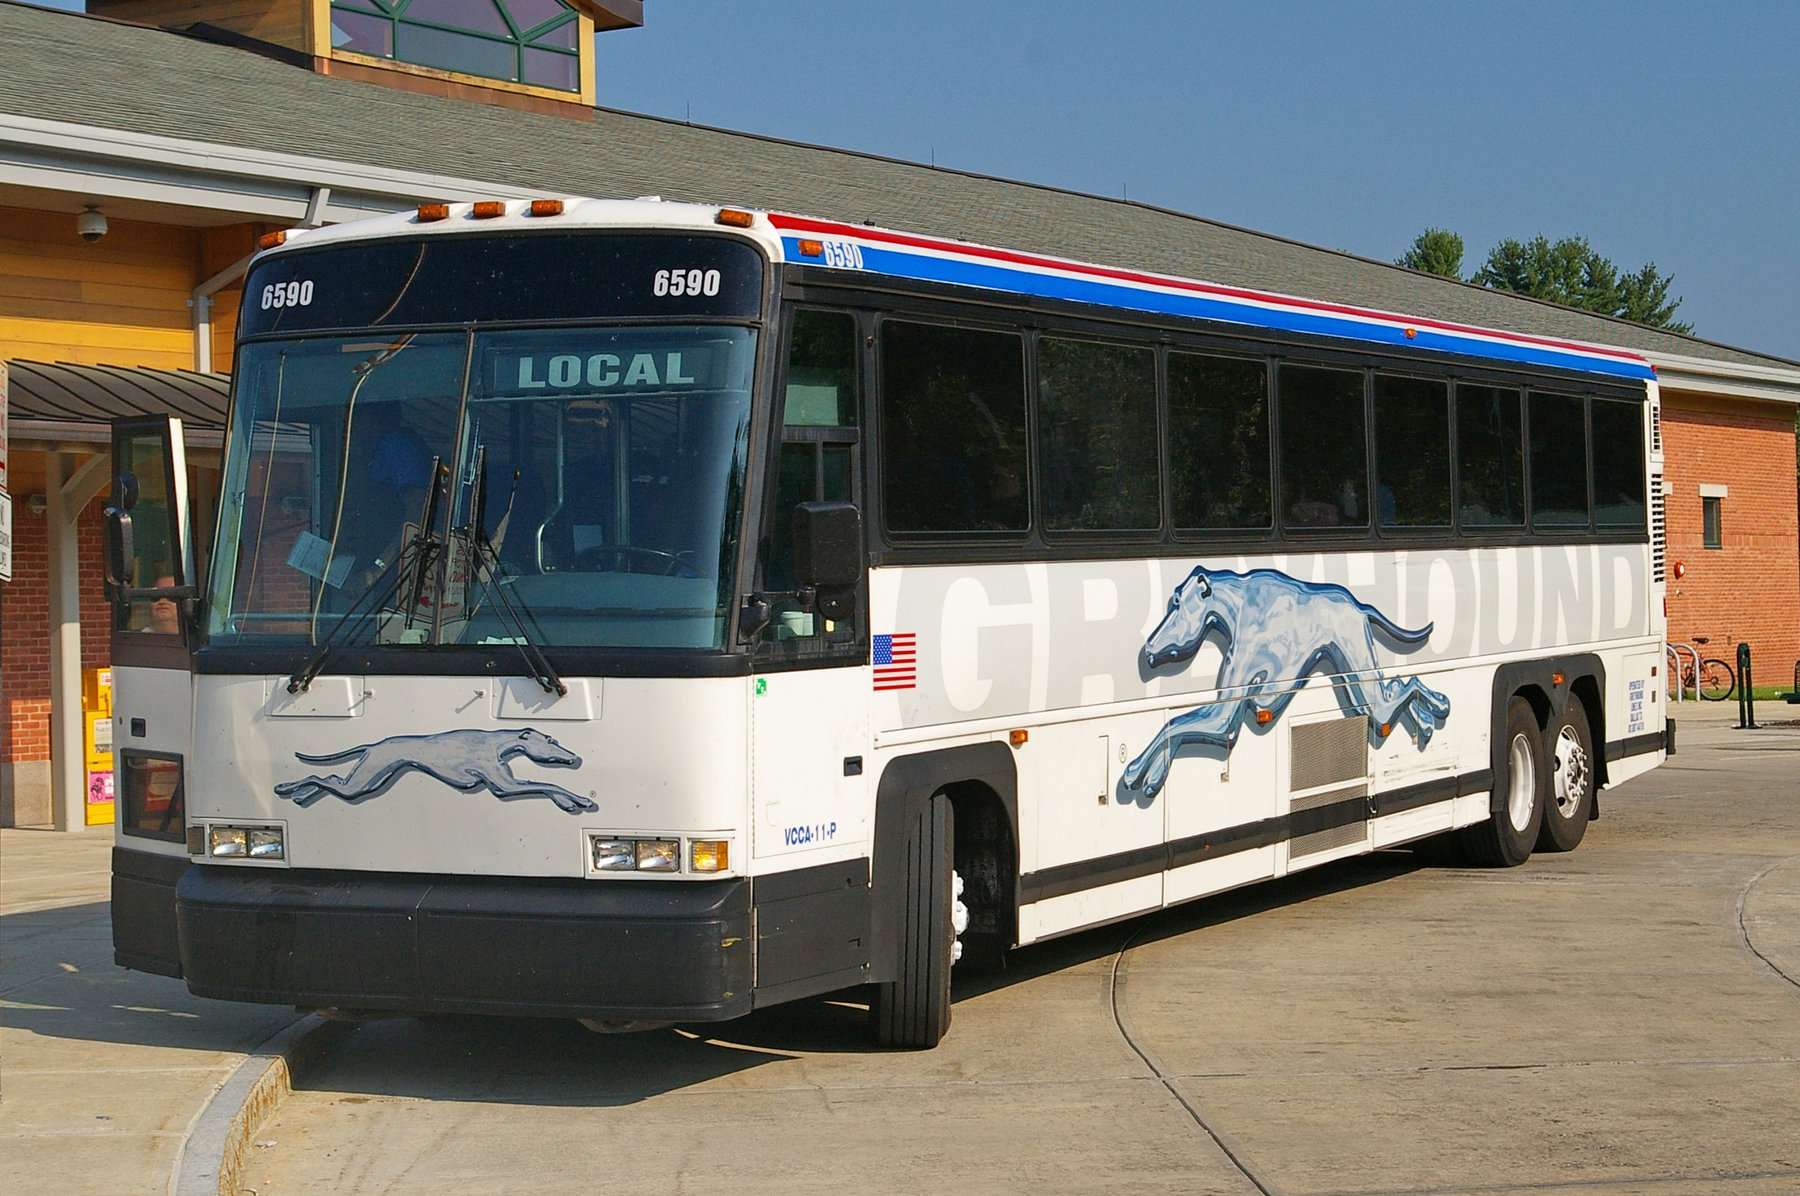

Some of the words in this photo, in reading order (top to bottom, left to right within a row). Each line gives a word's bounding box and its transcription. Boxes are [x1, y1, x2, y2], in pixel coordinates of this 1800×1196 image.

[822, 240, 864, 269] 6590
[261, 280, 314, 310] 6590
[653, 269, 721, 297] 6590
[518, 352, 695, 388] LOCAL
[895, 543, 1645, 729] GRHOUND
[784, 822, 837, 846] VCCA-11-P
